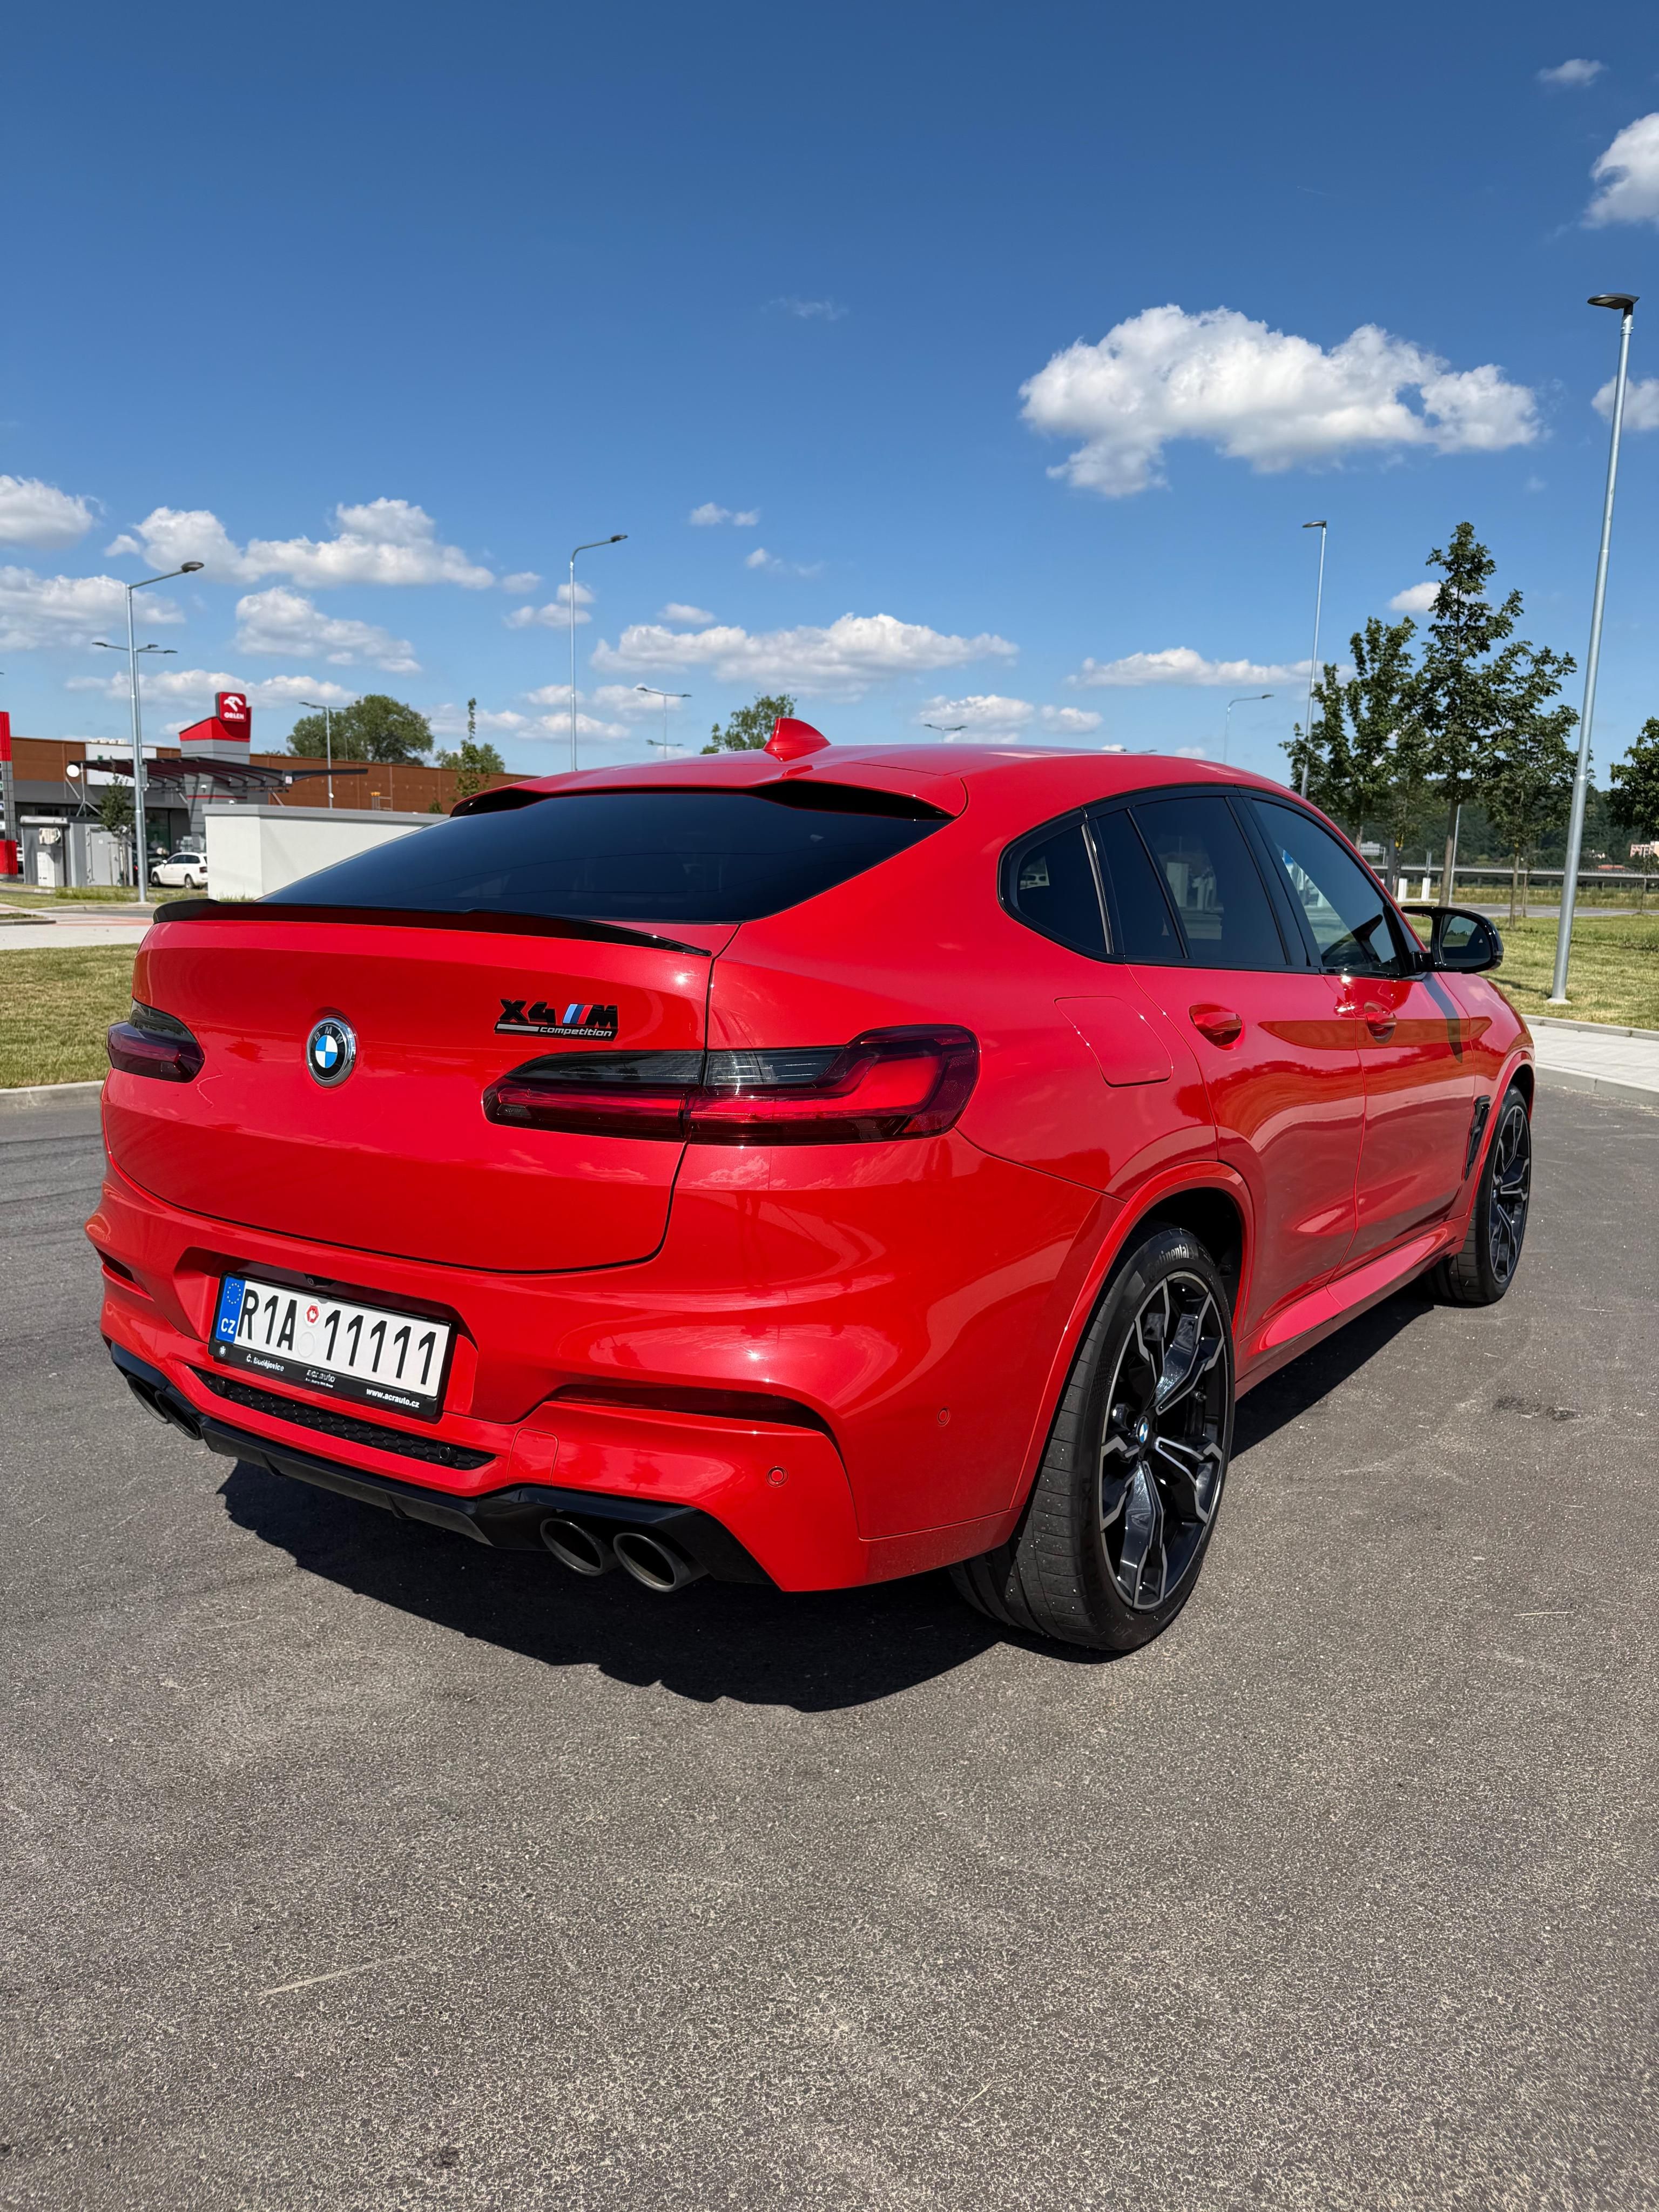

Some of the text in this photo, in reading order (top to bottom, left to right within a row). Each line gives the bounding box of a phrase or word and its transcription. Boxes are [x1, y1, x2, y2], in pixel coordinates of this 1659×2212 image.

[499, 999, 556, 1025] X4
[314, 1026, 343, 1044] BMW
[540, 1027, 612, 1037] competition
[221, 1318, 236, 1334] CZ
[237, 1289, 436, 1385] R1A 11111
[366, 1388, 420, 1408] www.acrauto.cz
